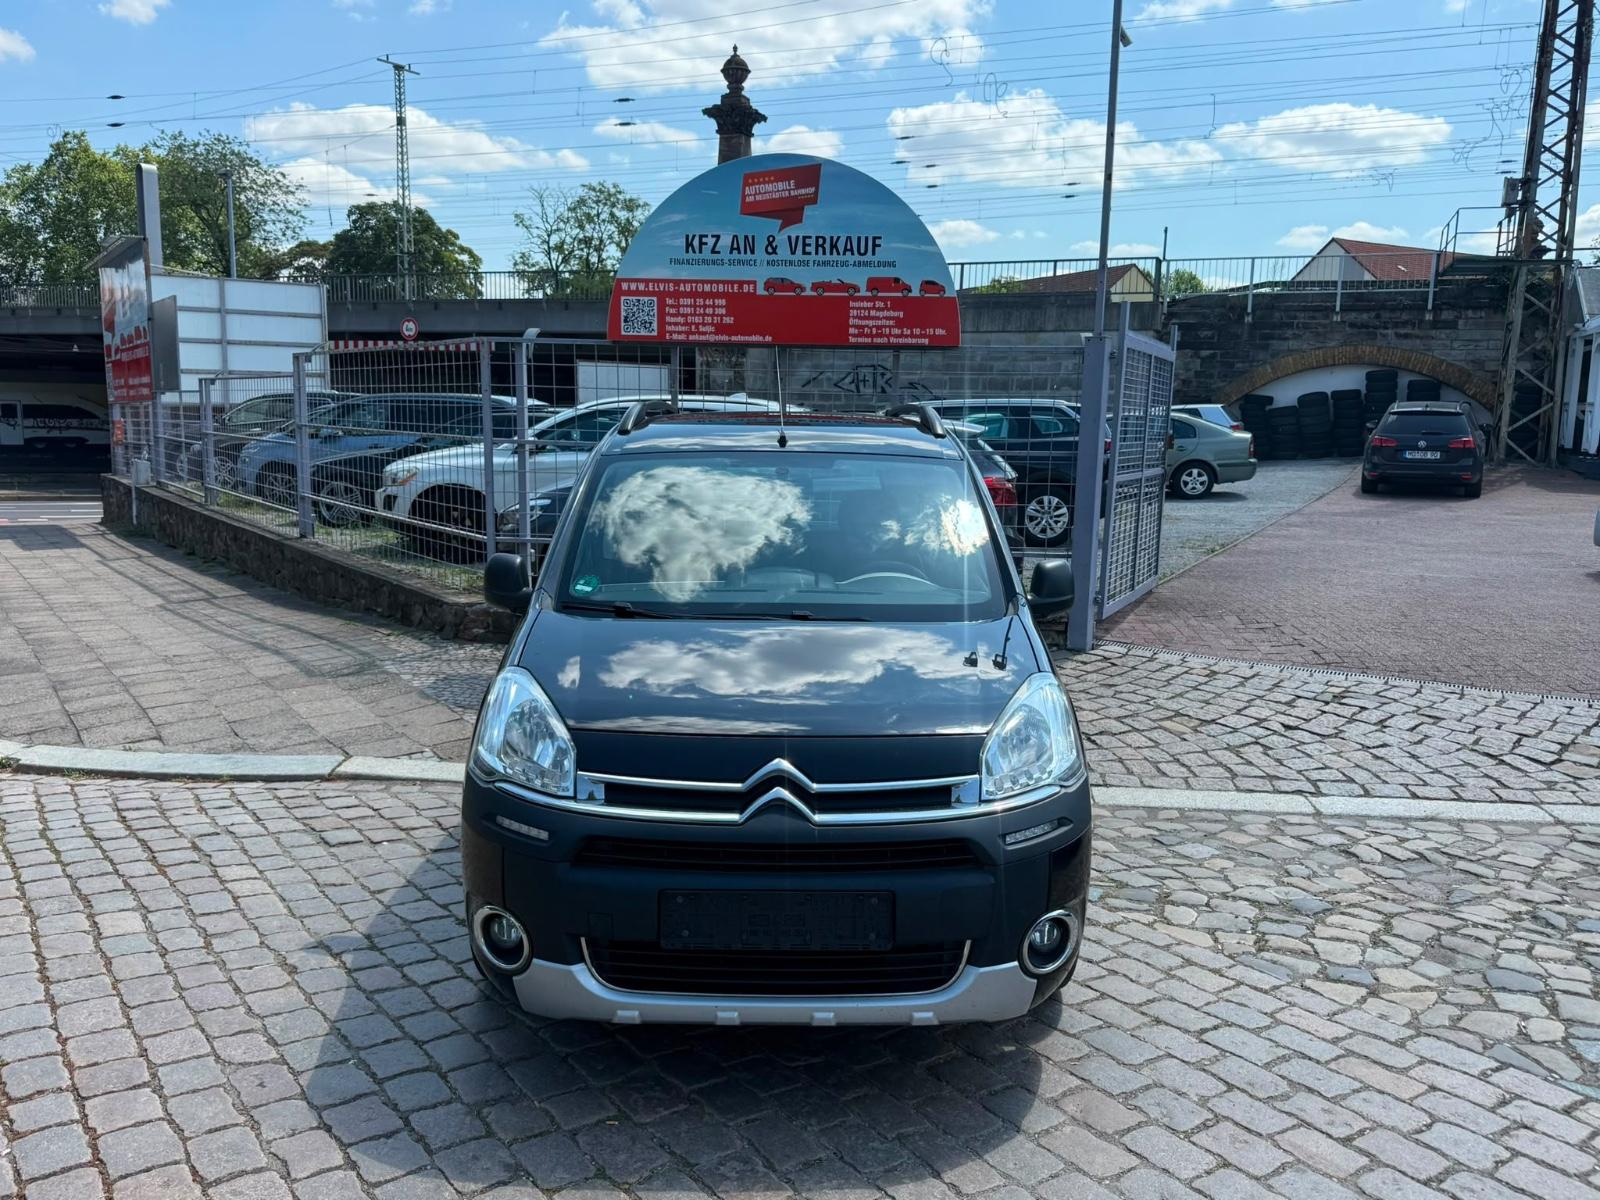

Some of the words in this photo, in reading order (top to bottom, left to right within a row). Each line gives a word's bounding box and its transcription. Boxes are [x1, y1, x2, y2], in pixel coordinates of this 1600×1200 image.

[745, 180, 796, 195] AUTOMOBILE
[685, 234, 721, 254] KFZ
[729, 234, 756, 255] AN
[764, 234, 778, 255] &
[788, 235, 882, 256] VERKAUF
[670, 258, 758, 267] FINANZIERUNGS-SERVICE
[766, 259, 810, 268] KOSTENLOSE
[812, 259, 897, 268] FAHRZEUG-ABMELDUNG
[621, 282, 755, 293] WWW.ELVIS-AUTOMOBILE.DE
[870, 310, 904, 318] Magdeburg
